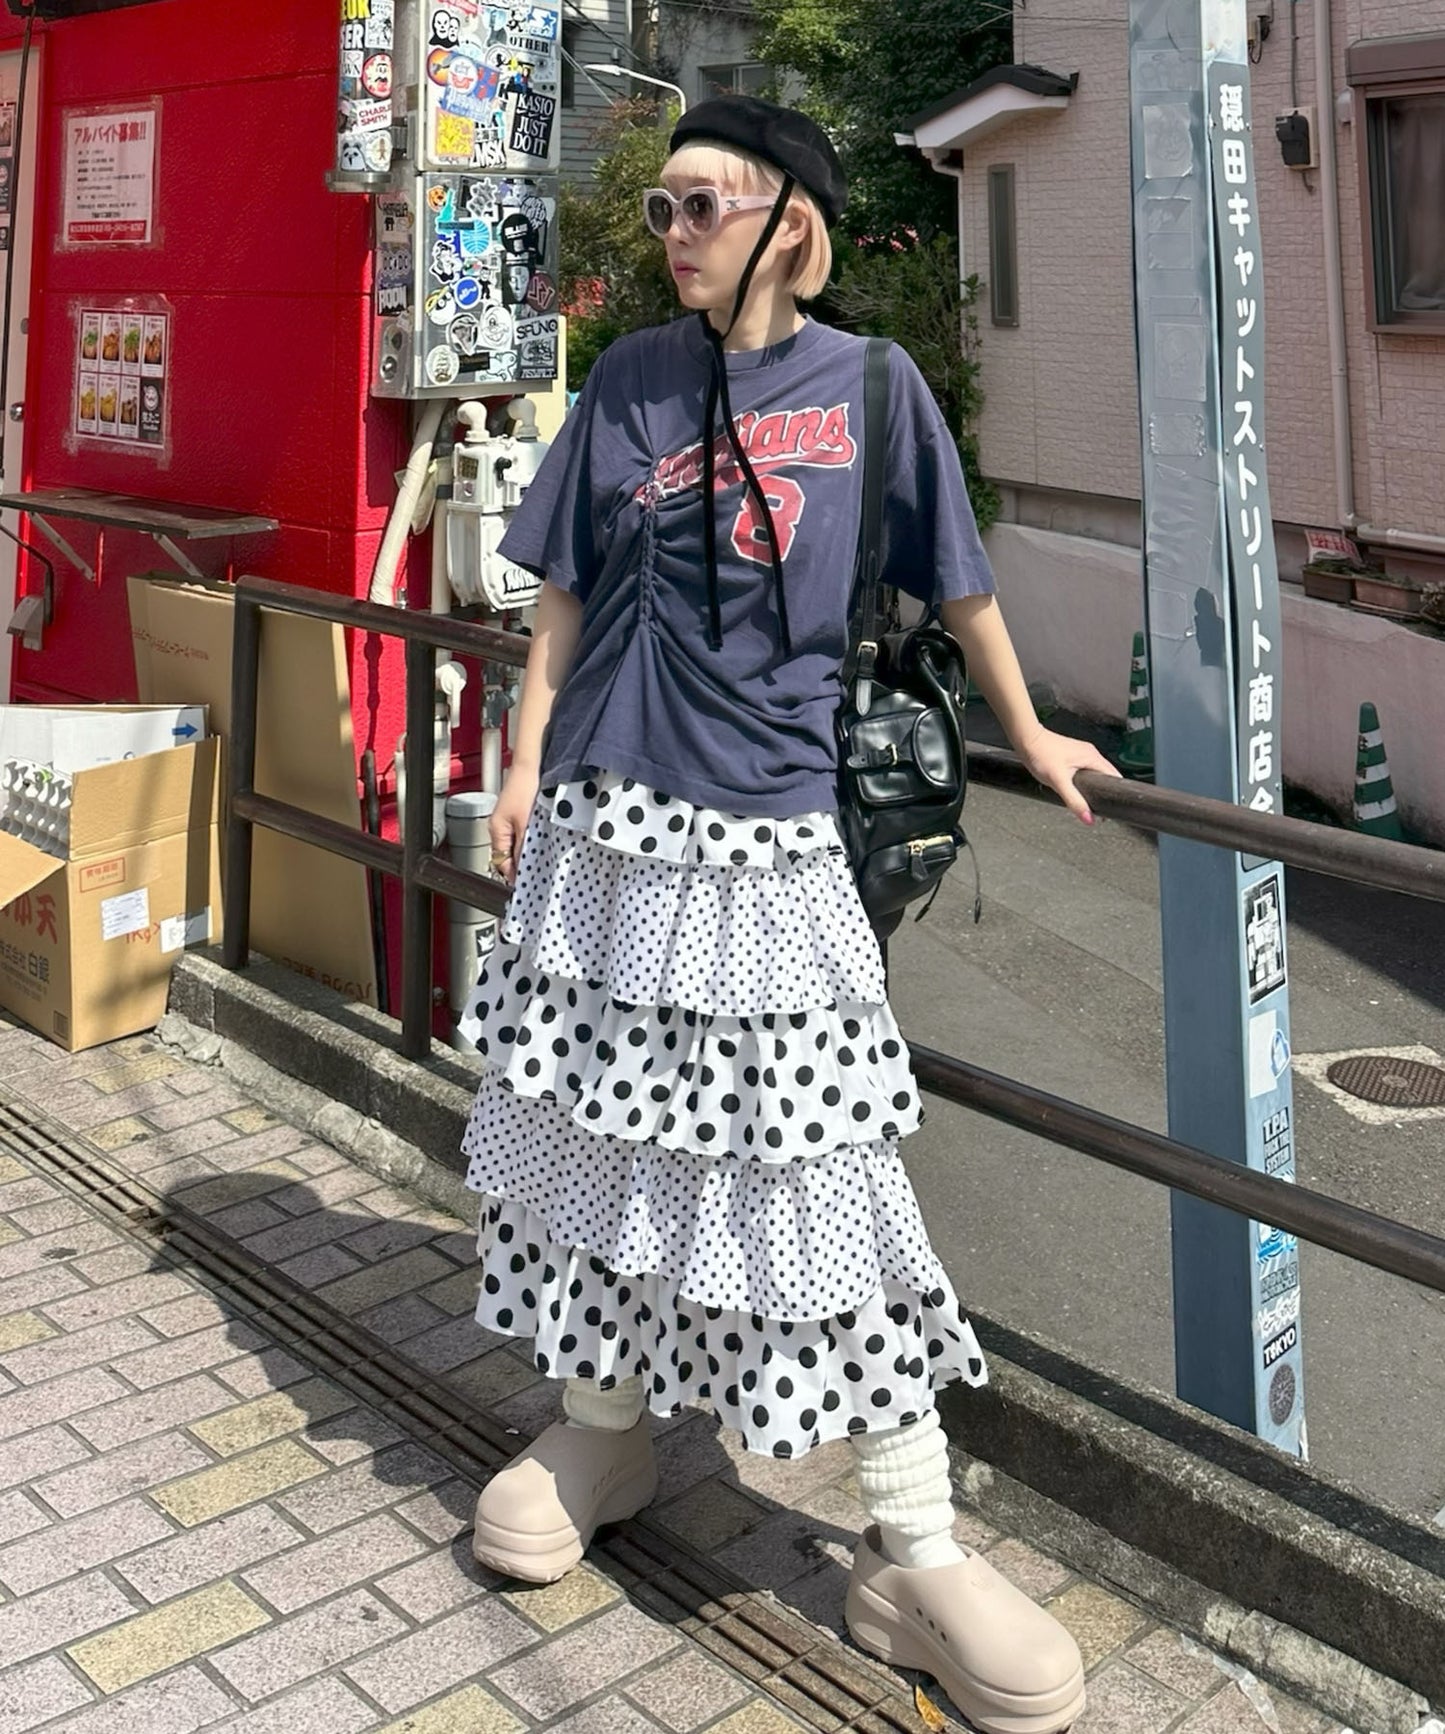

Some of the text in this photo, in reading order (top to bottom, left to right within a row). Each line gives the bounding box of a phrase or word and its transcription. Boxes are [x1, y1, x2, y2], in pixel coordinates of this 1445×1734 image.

[510, 37, 549, 54] OTHER
[518, 94, 553, 116] KASIO
[361, 114, 387, 126] SMITH
[517, 116, 547, 137] JUST
[513, 132, 547, 156] DO IT
[731, 473, 806, 567] 8
